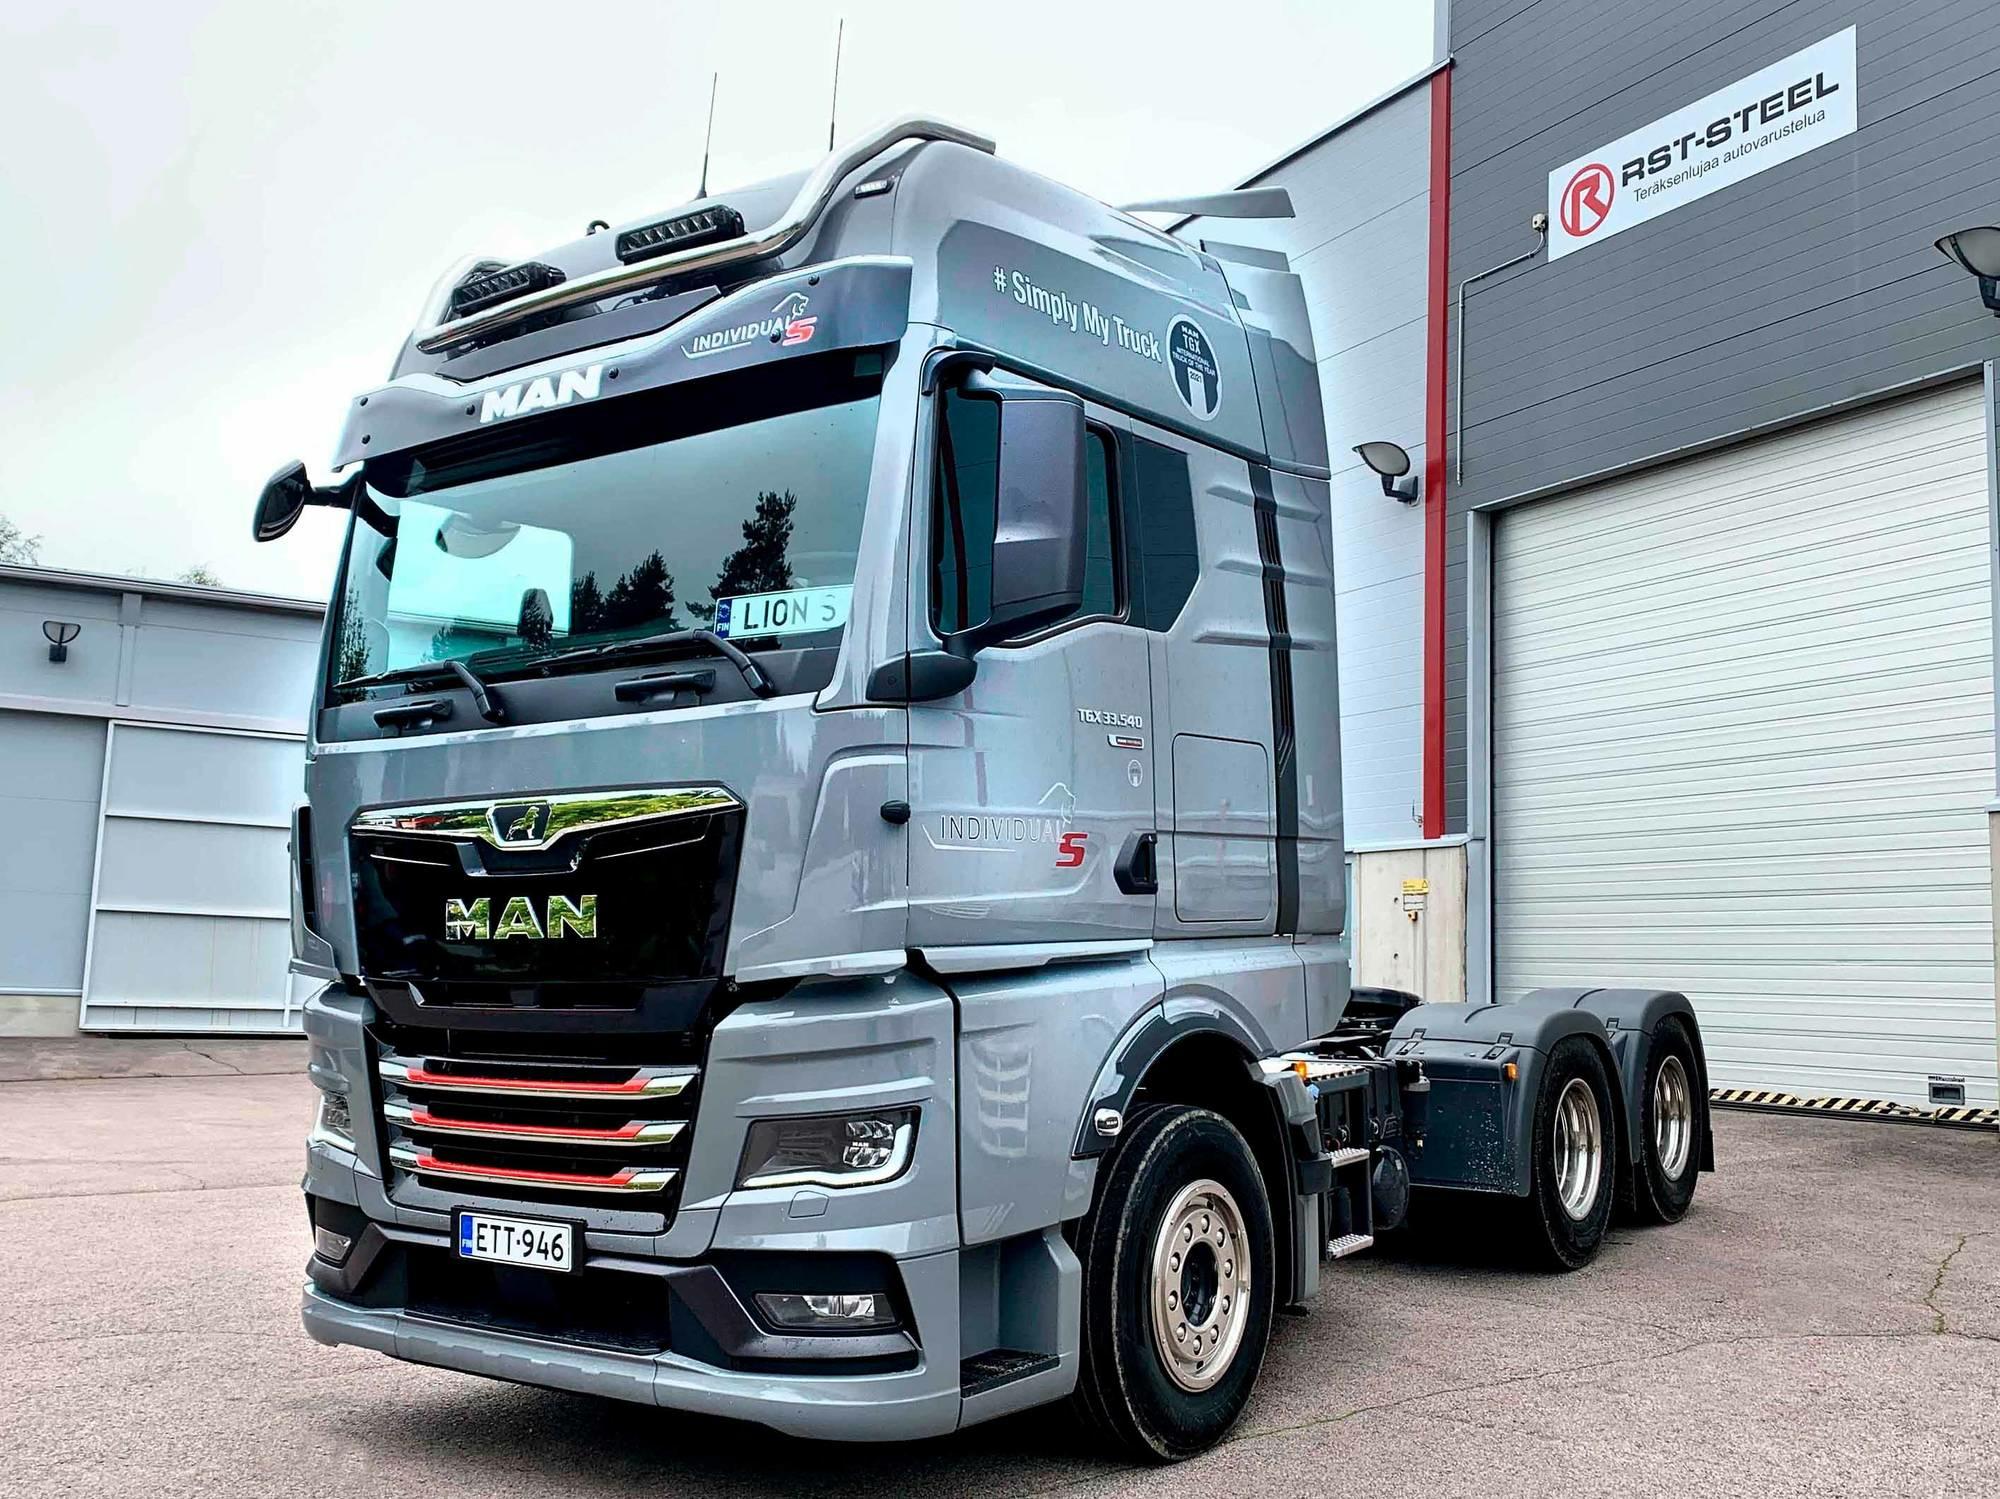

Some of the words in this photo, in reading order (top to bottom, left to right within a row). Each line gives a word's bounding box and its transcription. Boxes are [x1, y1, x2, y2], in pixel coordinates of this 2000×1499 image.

[1622, 72, 1839, 187] RST-STEEL
[1633, 156, 1719, 202] Teräksenlujaa
[1723, 109, 1826, 163] autovarustelua
[994, 266, 1007, 293] #
[1012, 270, 1078, 332] Simply
[1083, 301, 1110, 346] My
[1112, 315, 1162, 363] Truck
[693, 315, 790, 352] INDIVIDUAL
[1182, 333, 1201, 355] TGX
[480, 364, 603, 424] MAN
[716, 622, 729, 632] FIN
[743, 596, 808, 630] LION
[1077, 708, 1101, 724] TGX
[1102, 711, 1143, 729] 33.540
[940, 815, 1066, 843] INDIVIDUAL
[446, 894, 598, 941] MAN
